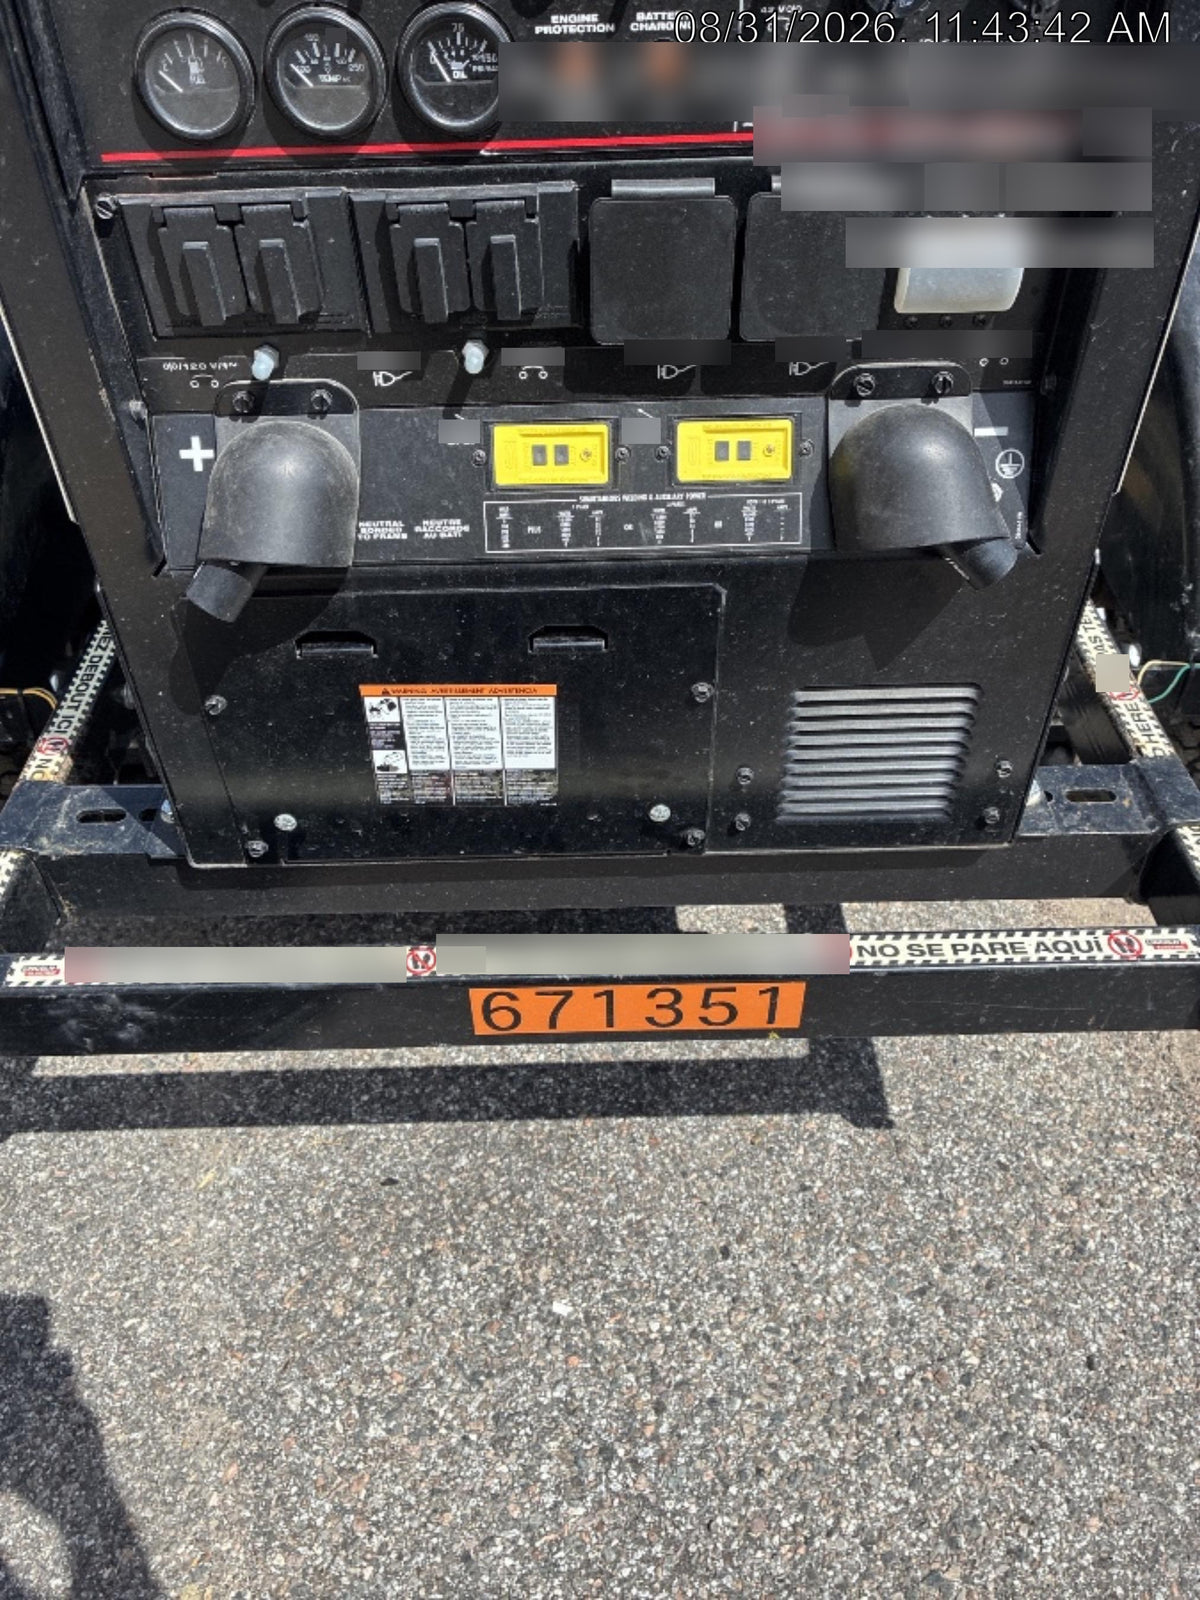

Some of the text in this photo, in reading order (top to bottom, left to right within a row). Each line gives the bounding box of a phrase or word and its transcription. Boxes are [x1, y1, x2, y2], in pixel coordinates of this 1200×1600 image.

[550, 13, 599, 24] ENGINE
[534, 24, 615, 35] PROTECTION
[318, 74, 342, 83] TEMP
[422, 519, 462, 527] NEUTRE
[67, 653, 104, 711] DEBOUT
[55, 715, 76, 733] ICI
[1125, 701, 1159, 746] HERE
[856, 944, 900, 958] NO
[906, 943, 946, 957] SE
[951, 941, 1028, 956] PARE
[481, 985, 781, 1032] 671351
